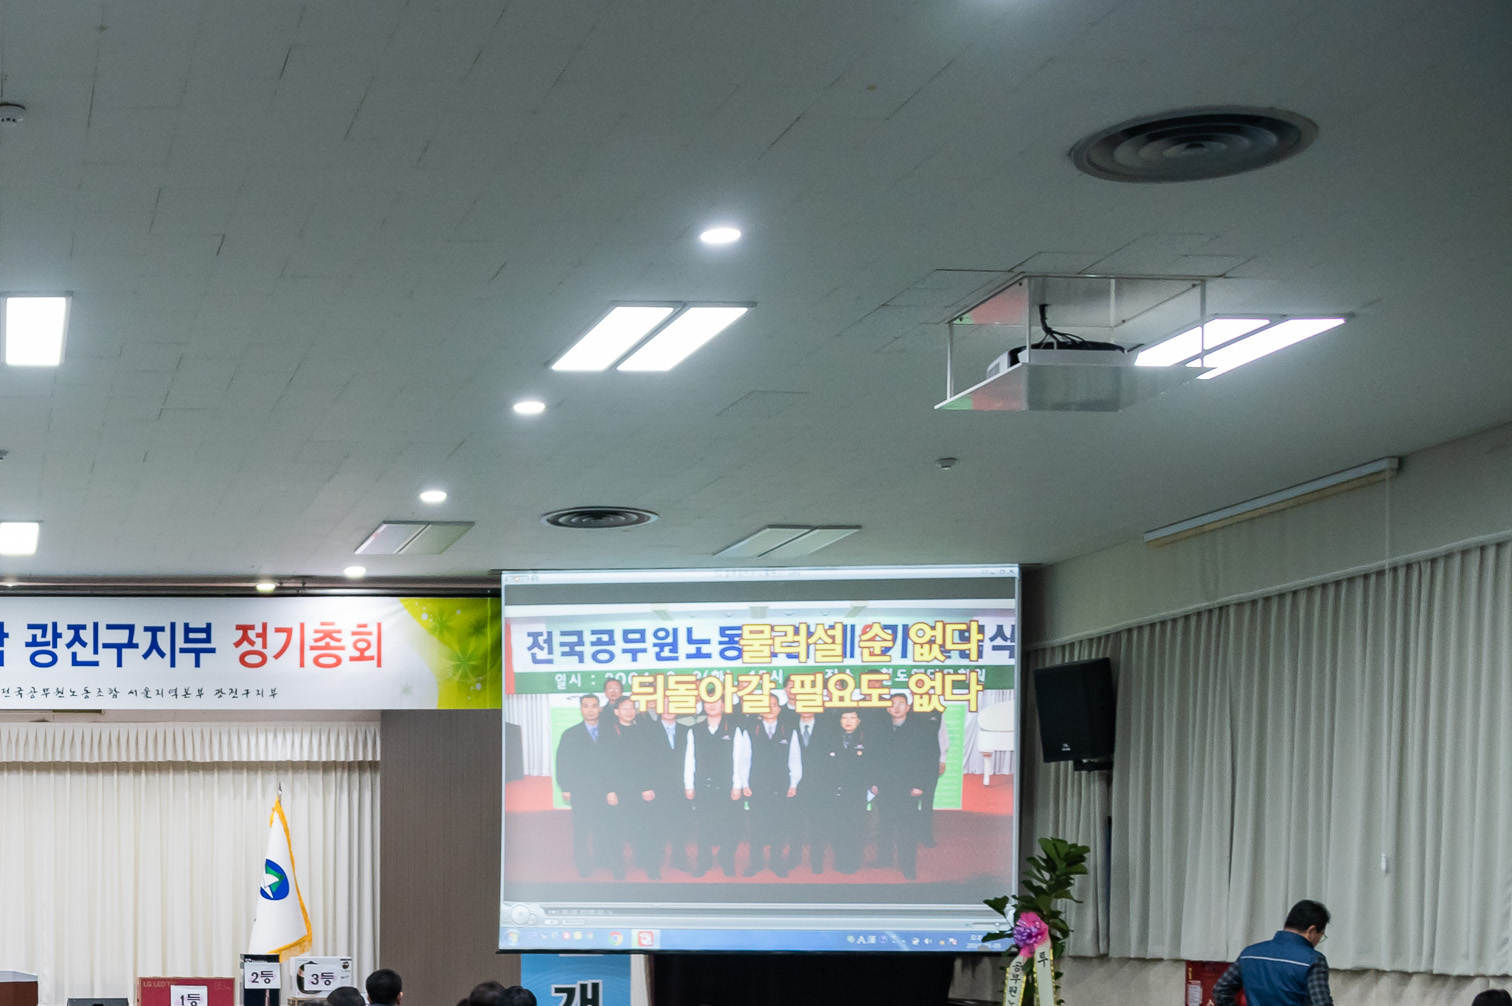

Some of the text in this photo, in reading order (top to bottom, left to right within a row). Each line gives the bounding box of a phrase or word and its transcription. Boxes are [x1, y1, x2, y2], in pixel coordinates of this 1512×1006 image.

[25, 621, 217, 669] 광진구지부
[233, 621, 383, 669] 정기총회
[739, 621, 844, 664] 물러설
[859, 621, 894, 663] 순
[908, 620, 984, 663] 없다
[555, 673, 582, 689] 일시
[1, 686, 279, 699] 전국공무원노동조합 서울지역본부 광진구지부
[630, 670, 984, 714] 뒤돌아갈 필요도 없다
[251, 970, 274, 984] 2등
[311, 972, 335, 986] 3등
[180, 993, 201, 1006] 1등
